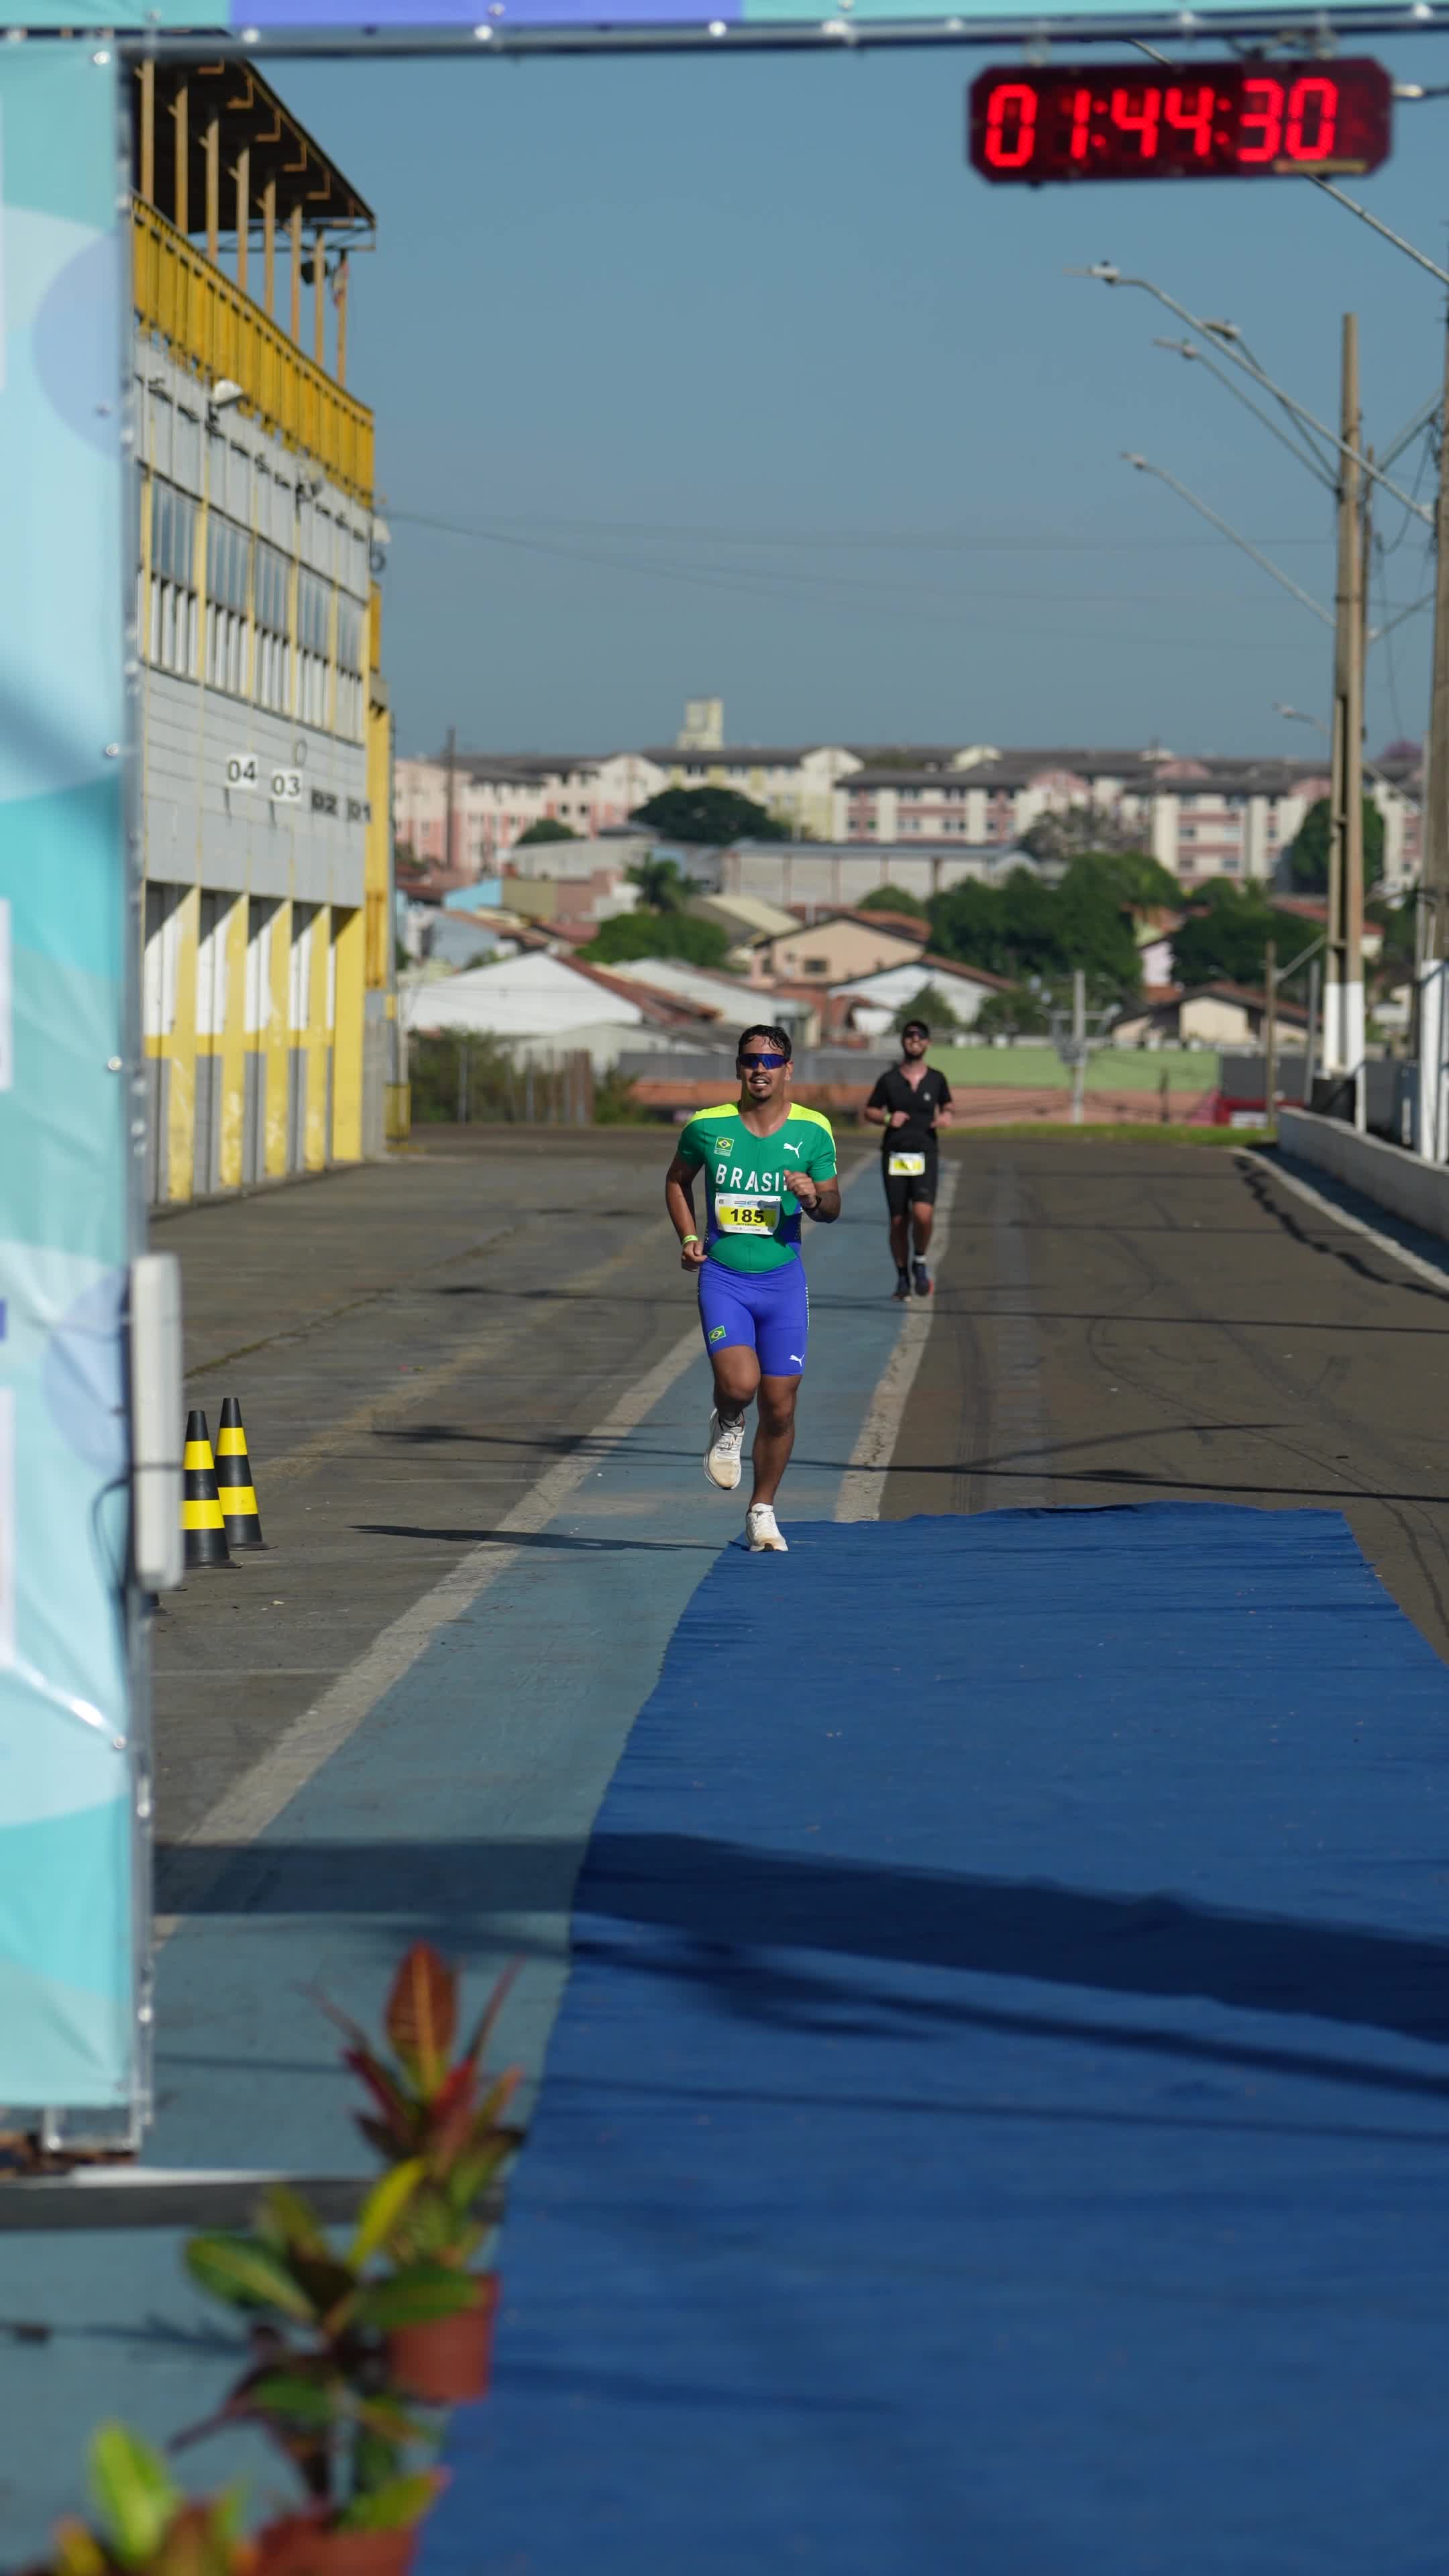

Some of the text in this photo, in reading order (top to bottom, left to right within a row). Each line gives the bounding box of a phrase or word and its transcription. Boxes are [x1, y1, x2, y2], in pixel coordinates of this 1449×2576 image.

[985, 78, 1338, 166] 01:44:30
[227, 760, 256, 782] 04
[272, 775, 301, 796] 03
[730, 1208, 764, 1224] 185
